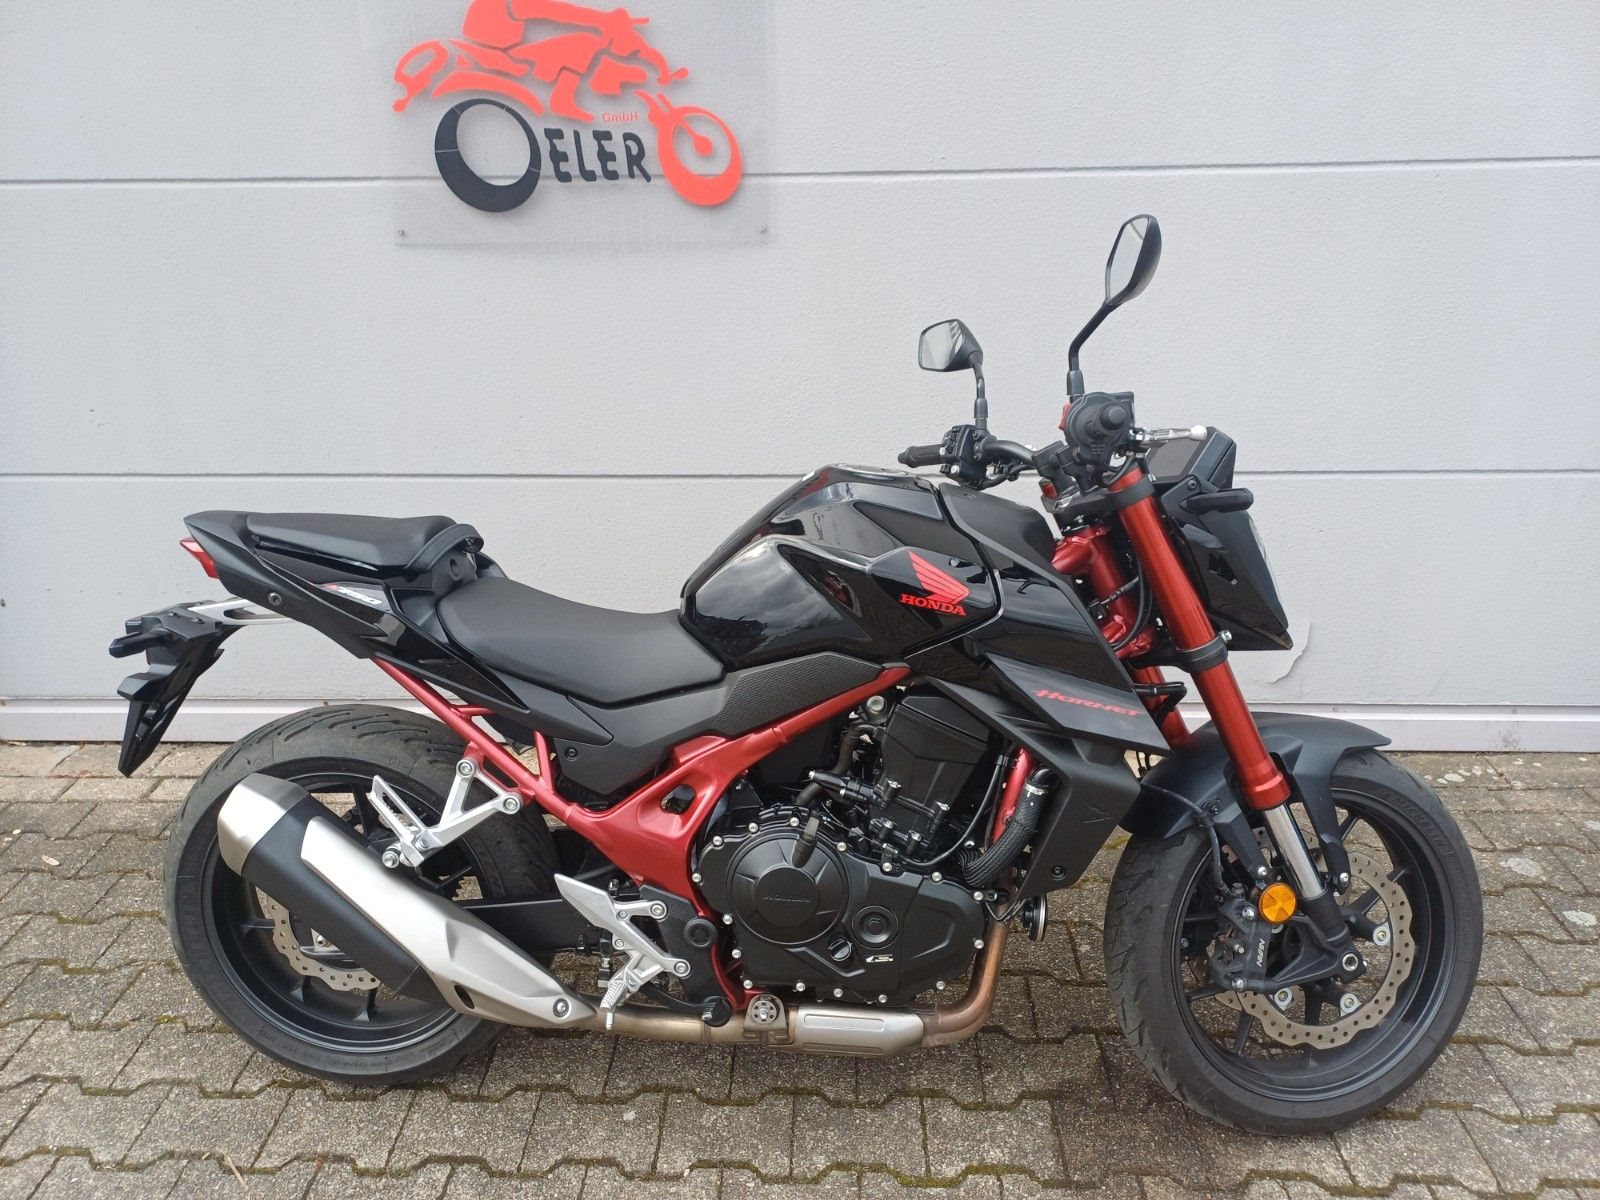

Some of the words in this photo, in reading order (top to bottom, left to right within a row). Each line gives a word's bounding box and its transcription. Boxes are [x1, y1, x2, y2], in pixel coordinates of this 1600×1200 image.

[602, 111, 638, 121] GmbH
[900, 593, 967, 616] HONDA
[1034, 689, 1144, 716] HORNET
